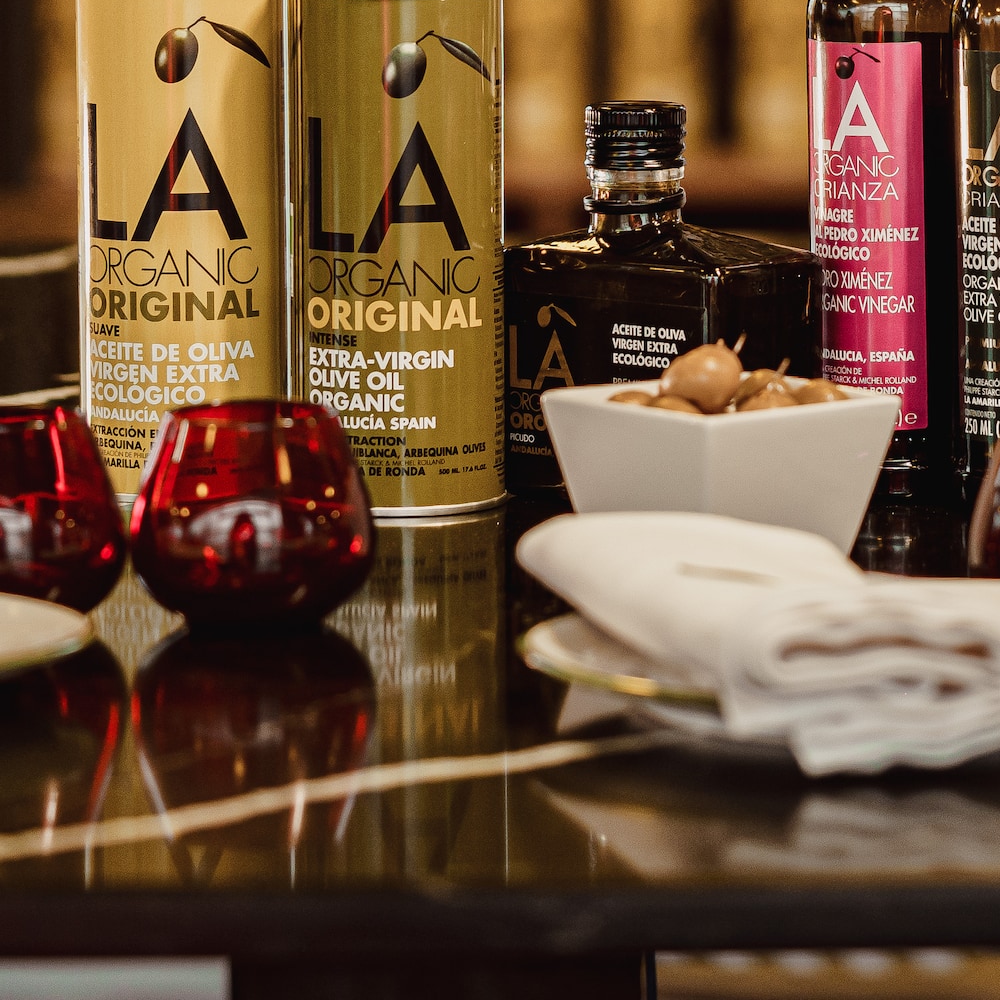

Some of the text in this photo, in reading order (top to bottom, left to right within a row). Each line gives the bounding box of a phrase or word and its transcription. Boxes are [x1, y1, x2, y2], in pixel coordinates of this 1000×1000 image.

[813, 152, 899, 178] ORGANIC
[813, 178, 899, 201] CRIANZA
[815, 224, 919, 242] AL PEDRO XIMÉNEZ
[962, 215, 996, 233] ACEITE
[815, 241, 871, 261] ECOLÓGICO
[90, 245, 259, 287] ORGANIC
[309, 255, 480, 298] ORGANIC
[841, 267, 893, 290] XIMÉNEZ
[90, 287, 260, 322] ORIGINAL
[859, 295, 915, 314] VINEGAR
[963, 291, 998, 307] EXTRA
[307, 296, 483, 333] ORIGINAL
[963, 307, 995, 324] OLIVE
[90, 322, 120, 337] SUAVE
[309, 331, 357, 347] INTENSE
[612, 323, 687, 342] ACEITE DE OLIVA
[90, 339, 255, 362] ACEITE DE OLIVA
[612, 337, 678, 355] VIRGEN EXTRA
[870, 347, 915, 362] ESPAÑA
[309, 346, 454, 371] EXTRA-VIRGIN
[509, 325, 575, 390] LA
[612, 352, 671, 369] ECOLÓGICO
[90, 361, 240, 383] VIRGEN EXTRA
[309, 366, 404, 391] OLIVE OIL
[853, 367, 862, 375] DE
[859, 377, 883, 385] MICHEL
[885, 375, 917, 384] ROLLAND
[90, 377, 206, 405] ECOLÓGICO
[309, 388, 405, 413] ORGANIC
[964, 395, 971, 404] LA
[390, 416, 437, 430] SPAIN
[965, 417, 978, 435] 250
[980, 419, 994, 436] ML
[347, 436, 407, 447] TRACTION
[404, 445, 459, 458] ARBEQUINA
[462, 441, 486, 455] OLIVES
[104, 457, 140, 469] MARILLA
[369, 466, 382, 477] DE
[386, 466, 426, 477] RONDA
